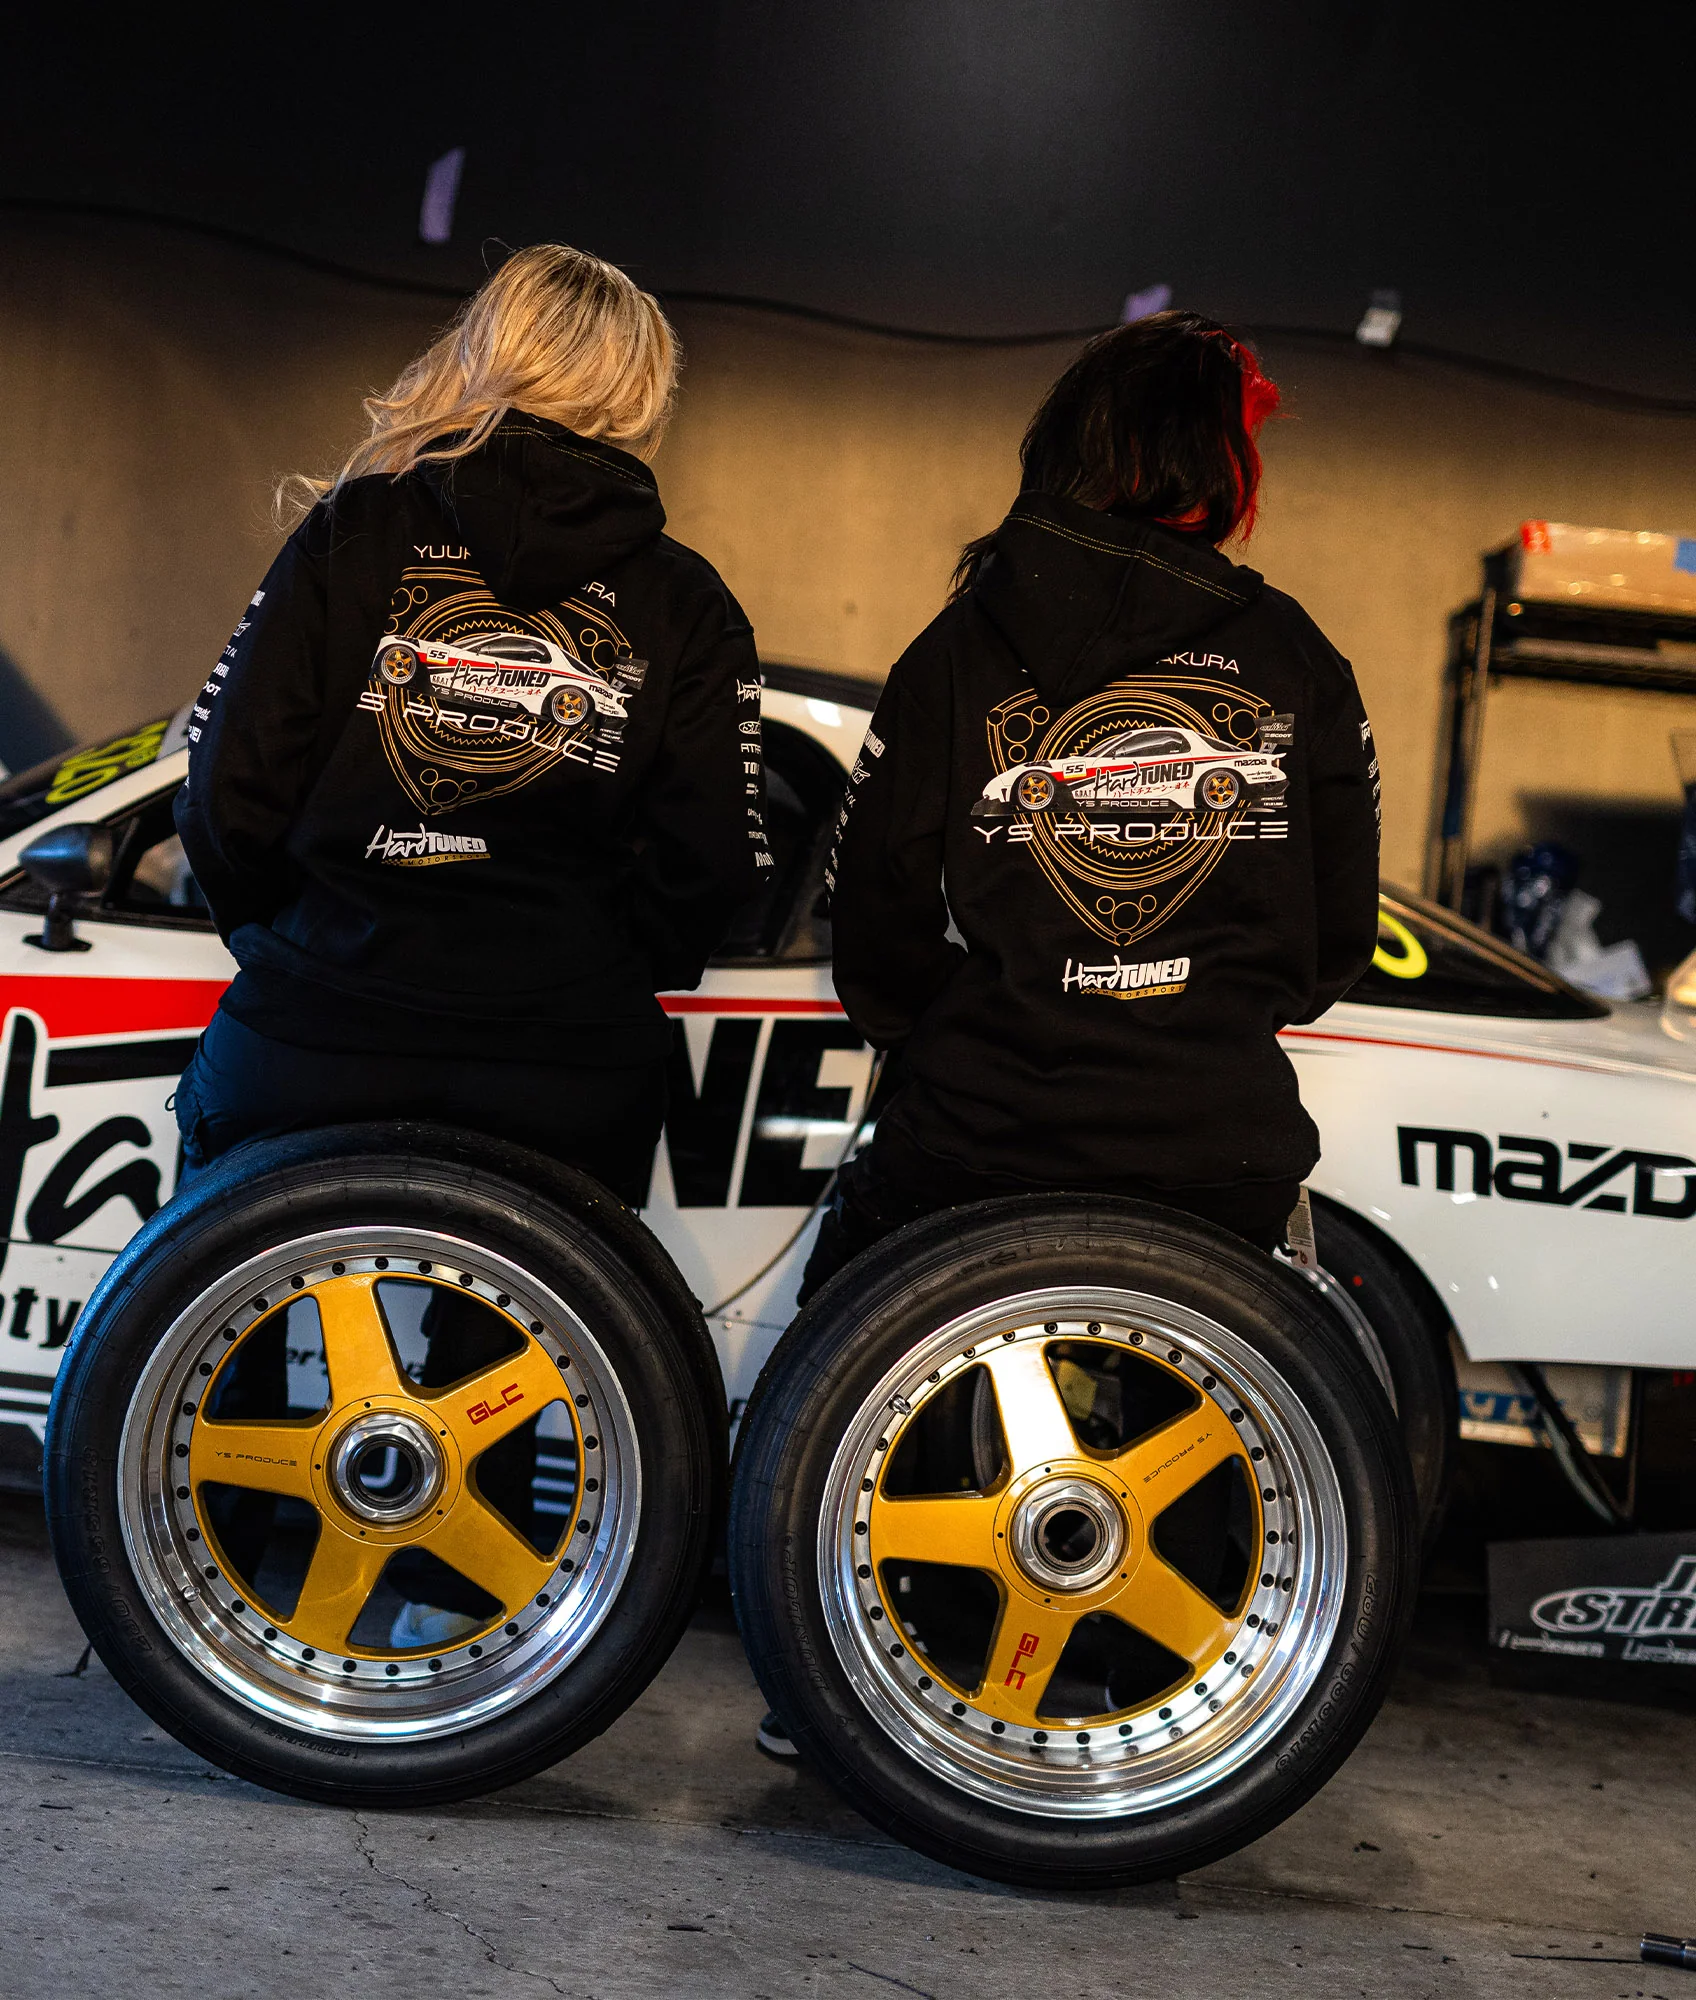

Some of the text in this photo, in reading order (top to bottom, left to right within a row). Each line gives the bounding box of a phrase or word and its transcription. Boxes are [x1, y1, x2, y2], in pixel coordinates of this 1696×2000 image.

[580, 581, 615, 607] RA
[428, 649, 448, 660] 55
[454, 691, 519, 709] PRODUCE
[403, 701, 621, 773] PRODUCE
[1065, 764, 1084, 774] 55
[1234, 758, 1267, 767] mazda
[1076, 800, 1169, 808] YS PRODUCE
[973, 820, 1289, 843] YS PRODUCE
[1103, 985, 1184, 998] MOTORSPORT
[0, 1286, 83, 1349] ty
[466, 1383, 524, 1425] GLC
[215, 1451, 297, 1466] YS PRODUCE
[1143, 1433, 1212, 1483] YS PRODUCE
[1004, 1632, 1040, 1691] GLC
